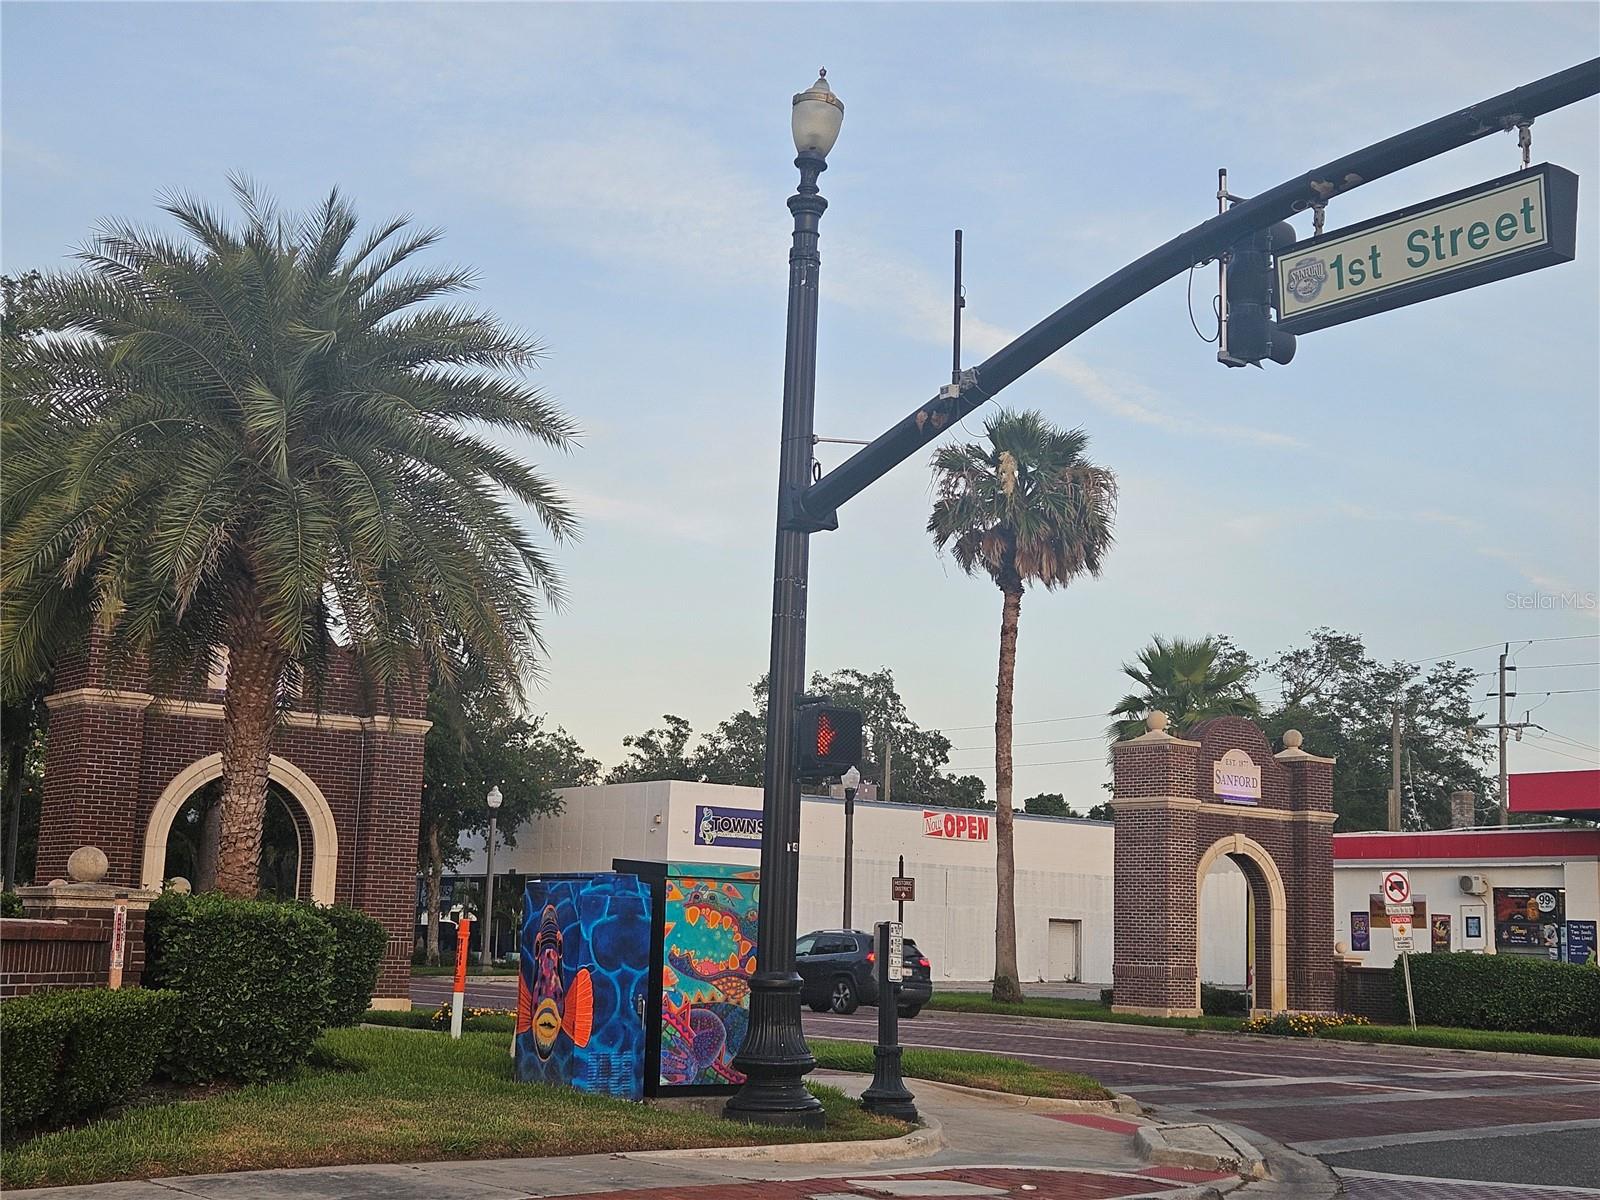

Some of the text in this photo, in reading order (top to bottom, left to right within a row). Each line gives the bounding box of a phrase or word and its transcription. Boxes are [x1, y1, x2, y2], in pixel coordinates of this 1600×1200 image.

[1330, 197, 1536, 290] 1st Street
[1215, 769, 1258, 789] SANFORD
[943, 813, 989, 840] OPEN
